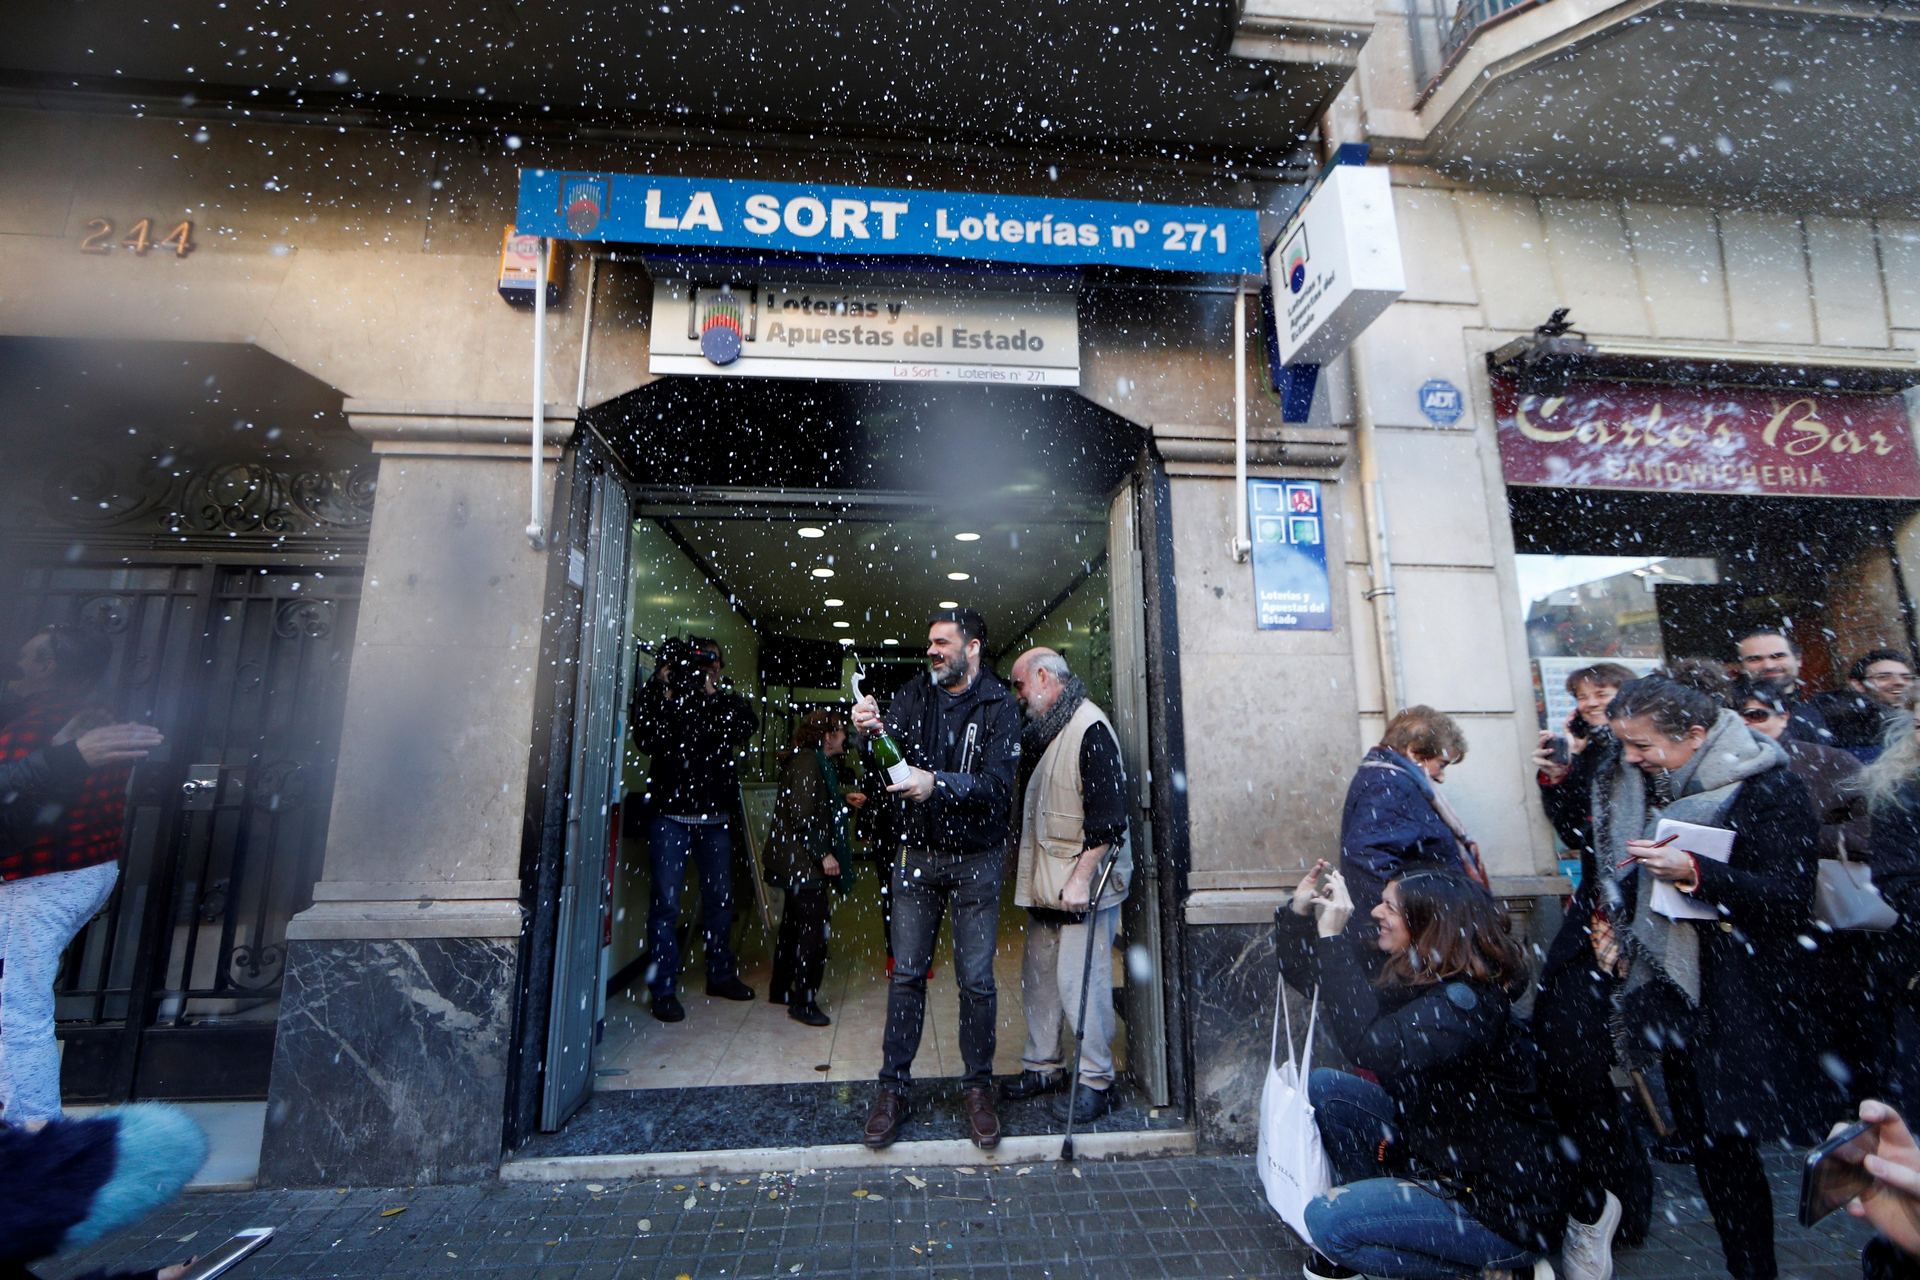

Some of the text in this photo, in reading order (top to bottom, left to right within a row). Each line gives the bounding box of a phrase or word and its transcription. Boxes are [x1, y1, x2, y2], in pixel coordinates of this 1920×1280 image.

[644, 189, 724, 232] LA
[742, 194, 909, 240] SORT
[936, 208, 1100, 246] Loterías
[1162, 222, 1227, 254] 271
[80, 217, 193, 256] 244
[766, 294, 903, 325] Loterías y
[766, 322, 1044, 352] Apuestas del Estado
[893, 366, 907, 378] La
[911, 366, 938, 378] Sort
[957, 368, 1006, 380] Loteries
[1027, 370, 1046, 382] 271
[1762, 398, 1894, 456] Bar
[1608, 460, 1826, 487] SANDWICHERIA
[1260, 590, 1311, 603] Loterías y
[1262, 602, 1325, 614] Apuestas del
[1262, 614, 1298, 625] Estado
